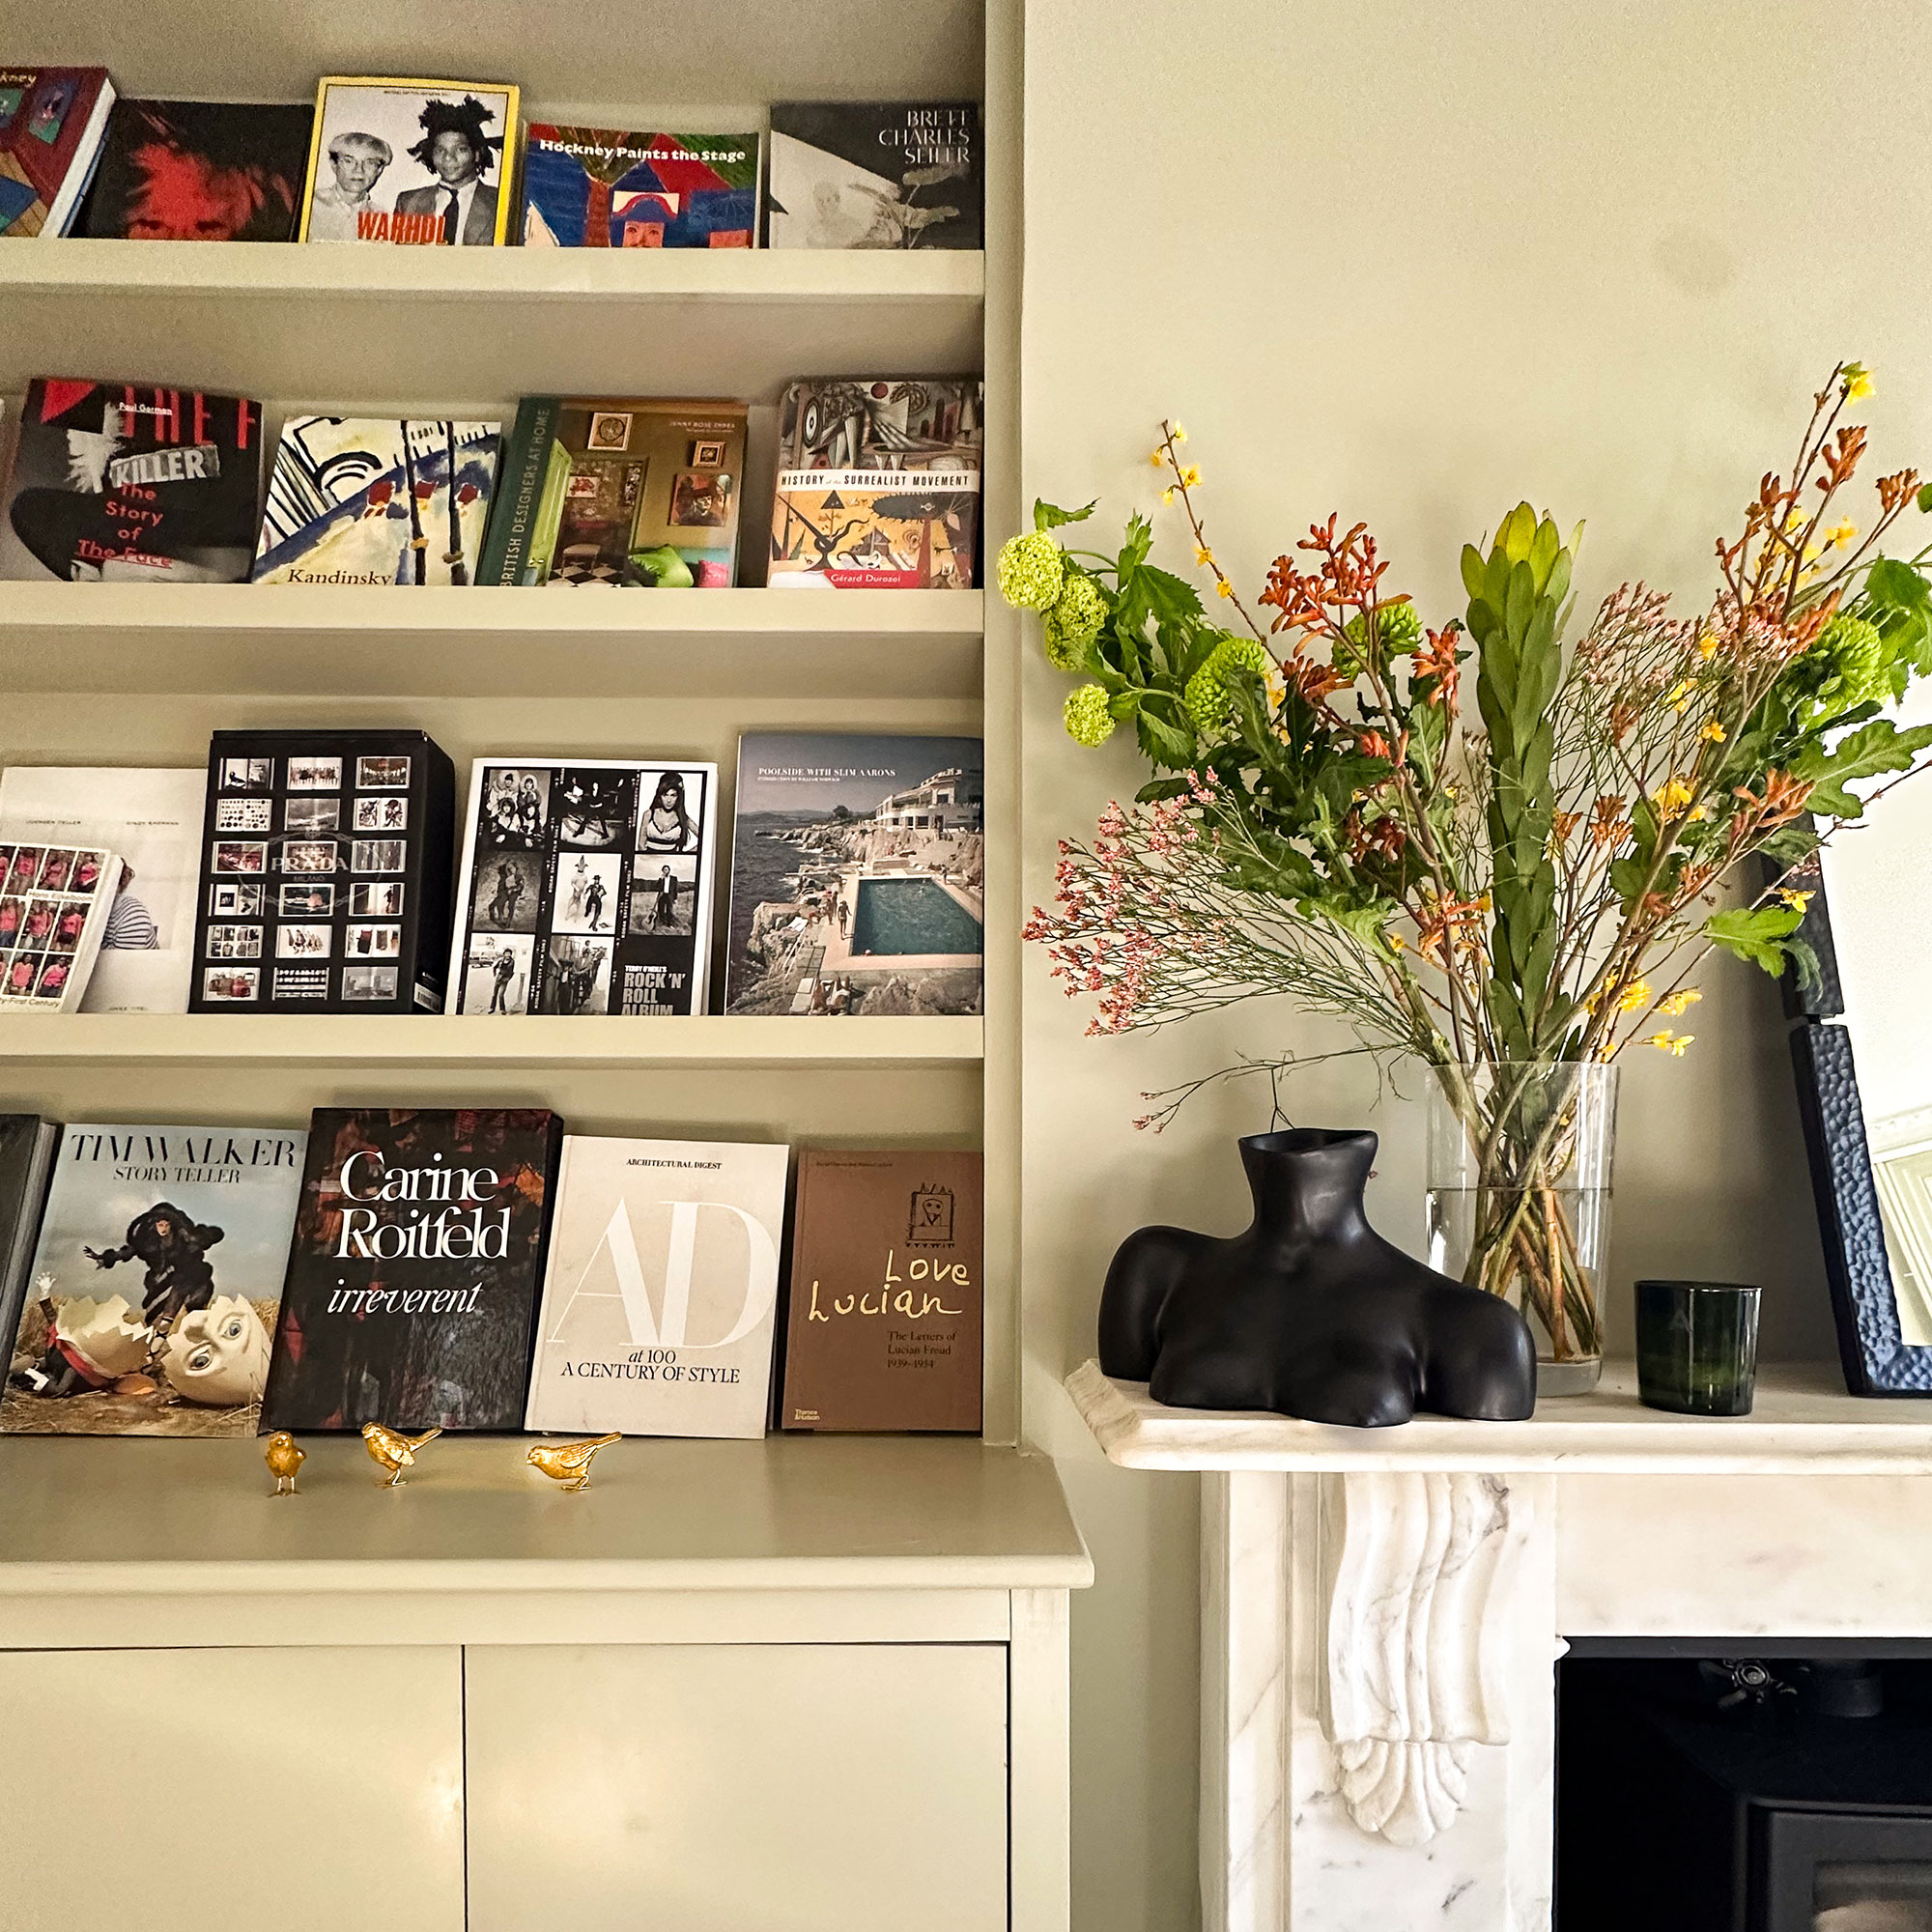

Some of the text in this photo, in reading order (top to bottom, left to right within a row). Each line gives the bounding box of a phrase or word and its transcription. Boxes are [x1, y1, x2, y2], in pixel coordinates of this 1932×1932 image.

[907, 110, 969, 127] BRETT
[878, 128, 970, 146] CHARLES
[540, 138, 746, 163] Hockney Paints the Stage
[357, 212, 447, 243] WARHOL
[119, 402, 137, 412] Paul
[112, 449, 208, 488] KILLER
[781, 474, 825, 486] HISTORY
[843, 474, 906, 487] SURREALIST
[912, 475, 969, 487] MOVEMENT
[121, 482, 157, 500] The
[499, 409, 551, 585] BRITISH DESIGNERS AT HOME
[105, 500, 164, 526] Story
[117, 526, 143, 540] of
[77, 538, 174, 567] The Face
[287, 569, 392, 585] Kandinsky
[831, 574, 901, 582] Gérard Durozoi
[758, 767, 805, 776] POOLSIDE
[834, 768, 857, 777] SLIM
[860, 768, 896, 777] AARONS
[270, 857, 349, 871] PRADA
[29, 891, 48, 899] Hans
[624, 972, 667, 988] ROCK
[668, 973, 687, 988] 'N'
[29, 998, 61, 1009] Century
[622, 988, 659, 1004] ROLL
[71, 1134, 296, 1167] TIM WALKER
[626, 1158, 723, 1170] ARCHITECTURAL DIGEST
[113, 1166, 241, 1183] STORY TELLER
[340, 1151, 499, 1202] Carine
[332, 1206, 511, 1260] Roitfeld
[546, 1197, 780, 1349] AD
[885, 1249, 971, 1286] Love
[327, 1277, 484, 1314] irreverent
[808, 1280, 963, 1322] Lucian
[887, 1329, 958, 1341] The Letters of
[628, 1350, 676, 1364] at 100
[887, 1344, 952, 1355] Lucian Freud
[560, 1361, 741, 1383] A CENTURY OF STYLE
